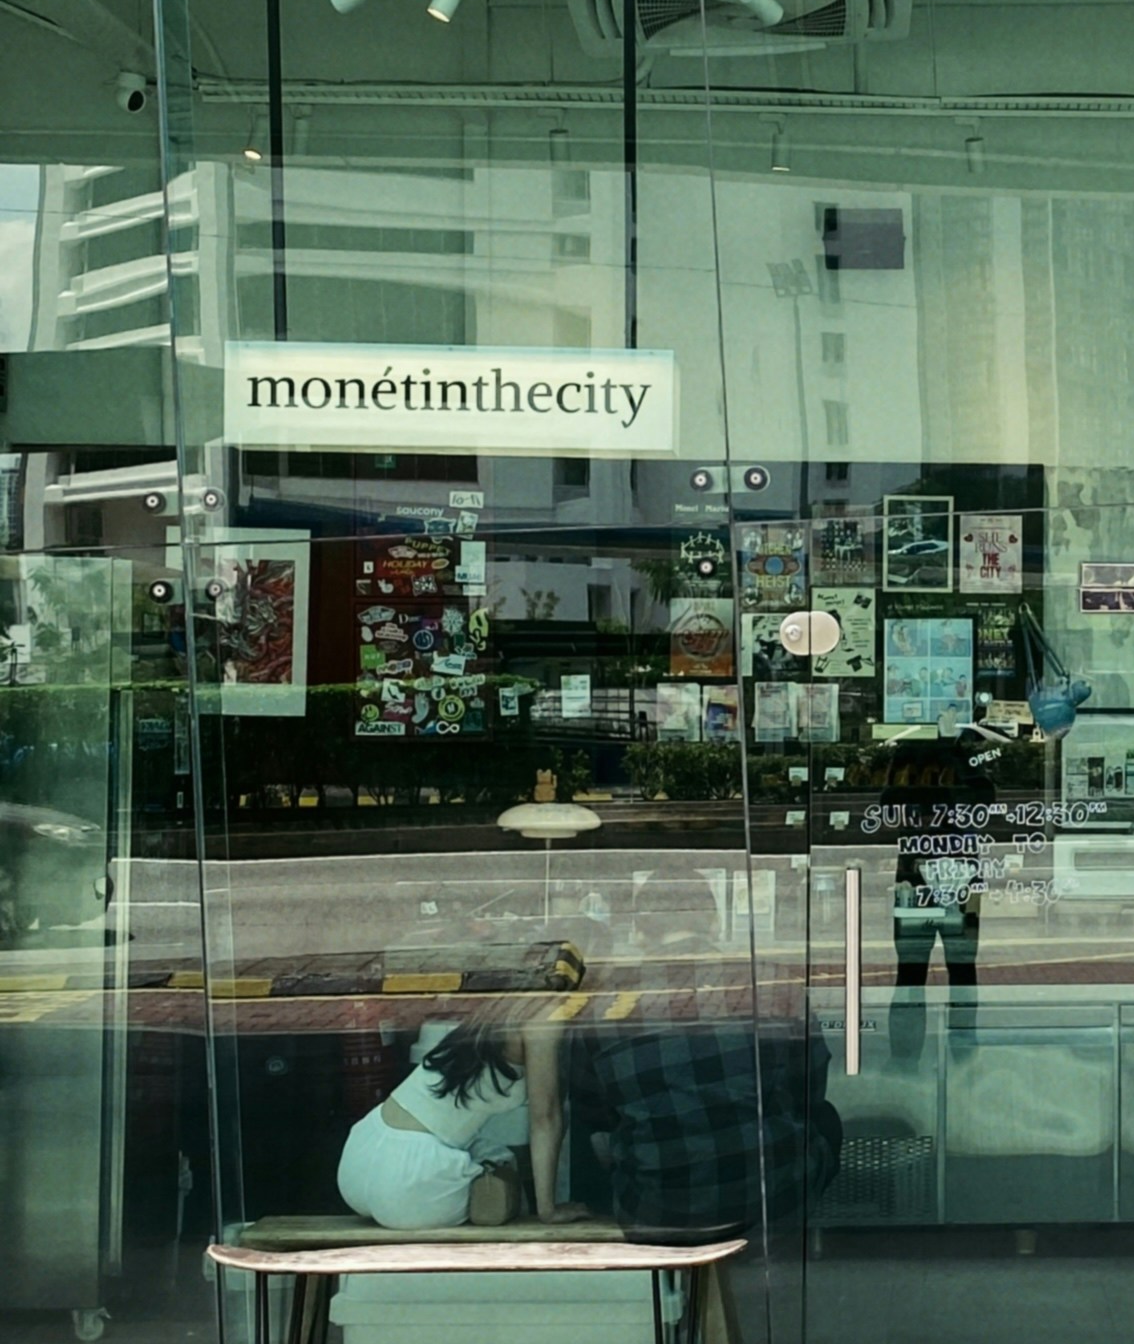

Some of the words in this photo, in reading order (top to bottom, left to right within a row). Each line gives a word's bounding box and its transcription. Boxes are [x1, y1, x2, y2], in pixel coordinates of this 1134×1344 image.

[246, 366, 653, 428] monétinthecity
[396, 506, 445, 517] saucony
[982, 553, 1000, 566] THE
[979, 565, 1001, 578] CITY
[358, 723, 402, 734] AGAINST
[968, 747, 1002, 767] OPEN
[861, 803, 923, 834] SUN
[897, 834, 996, 856] MONDAY
[1012, 832, 1048, 855] TO
[925, 857, 1009, 881] FRIDAY
